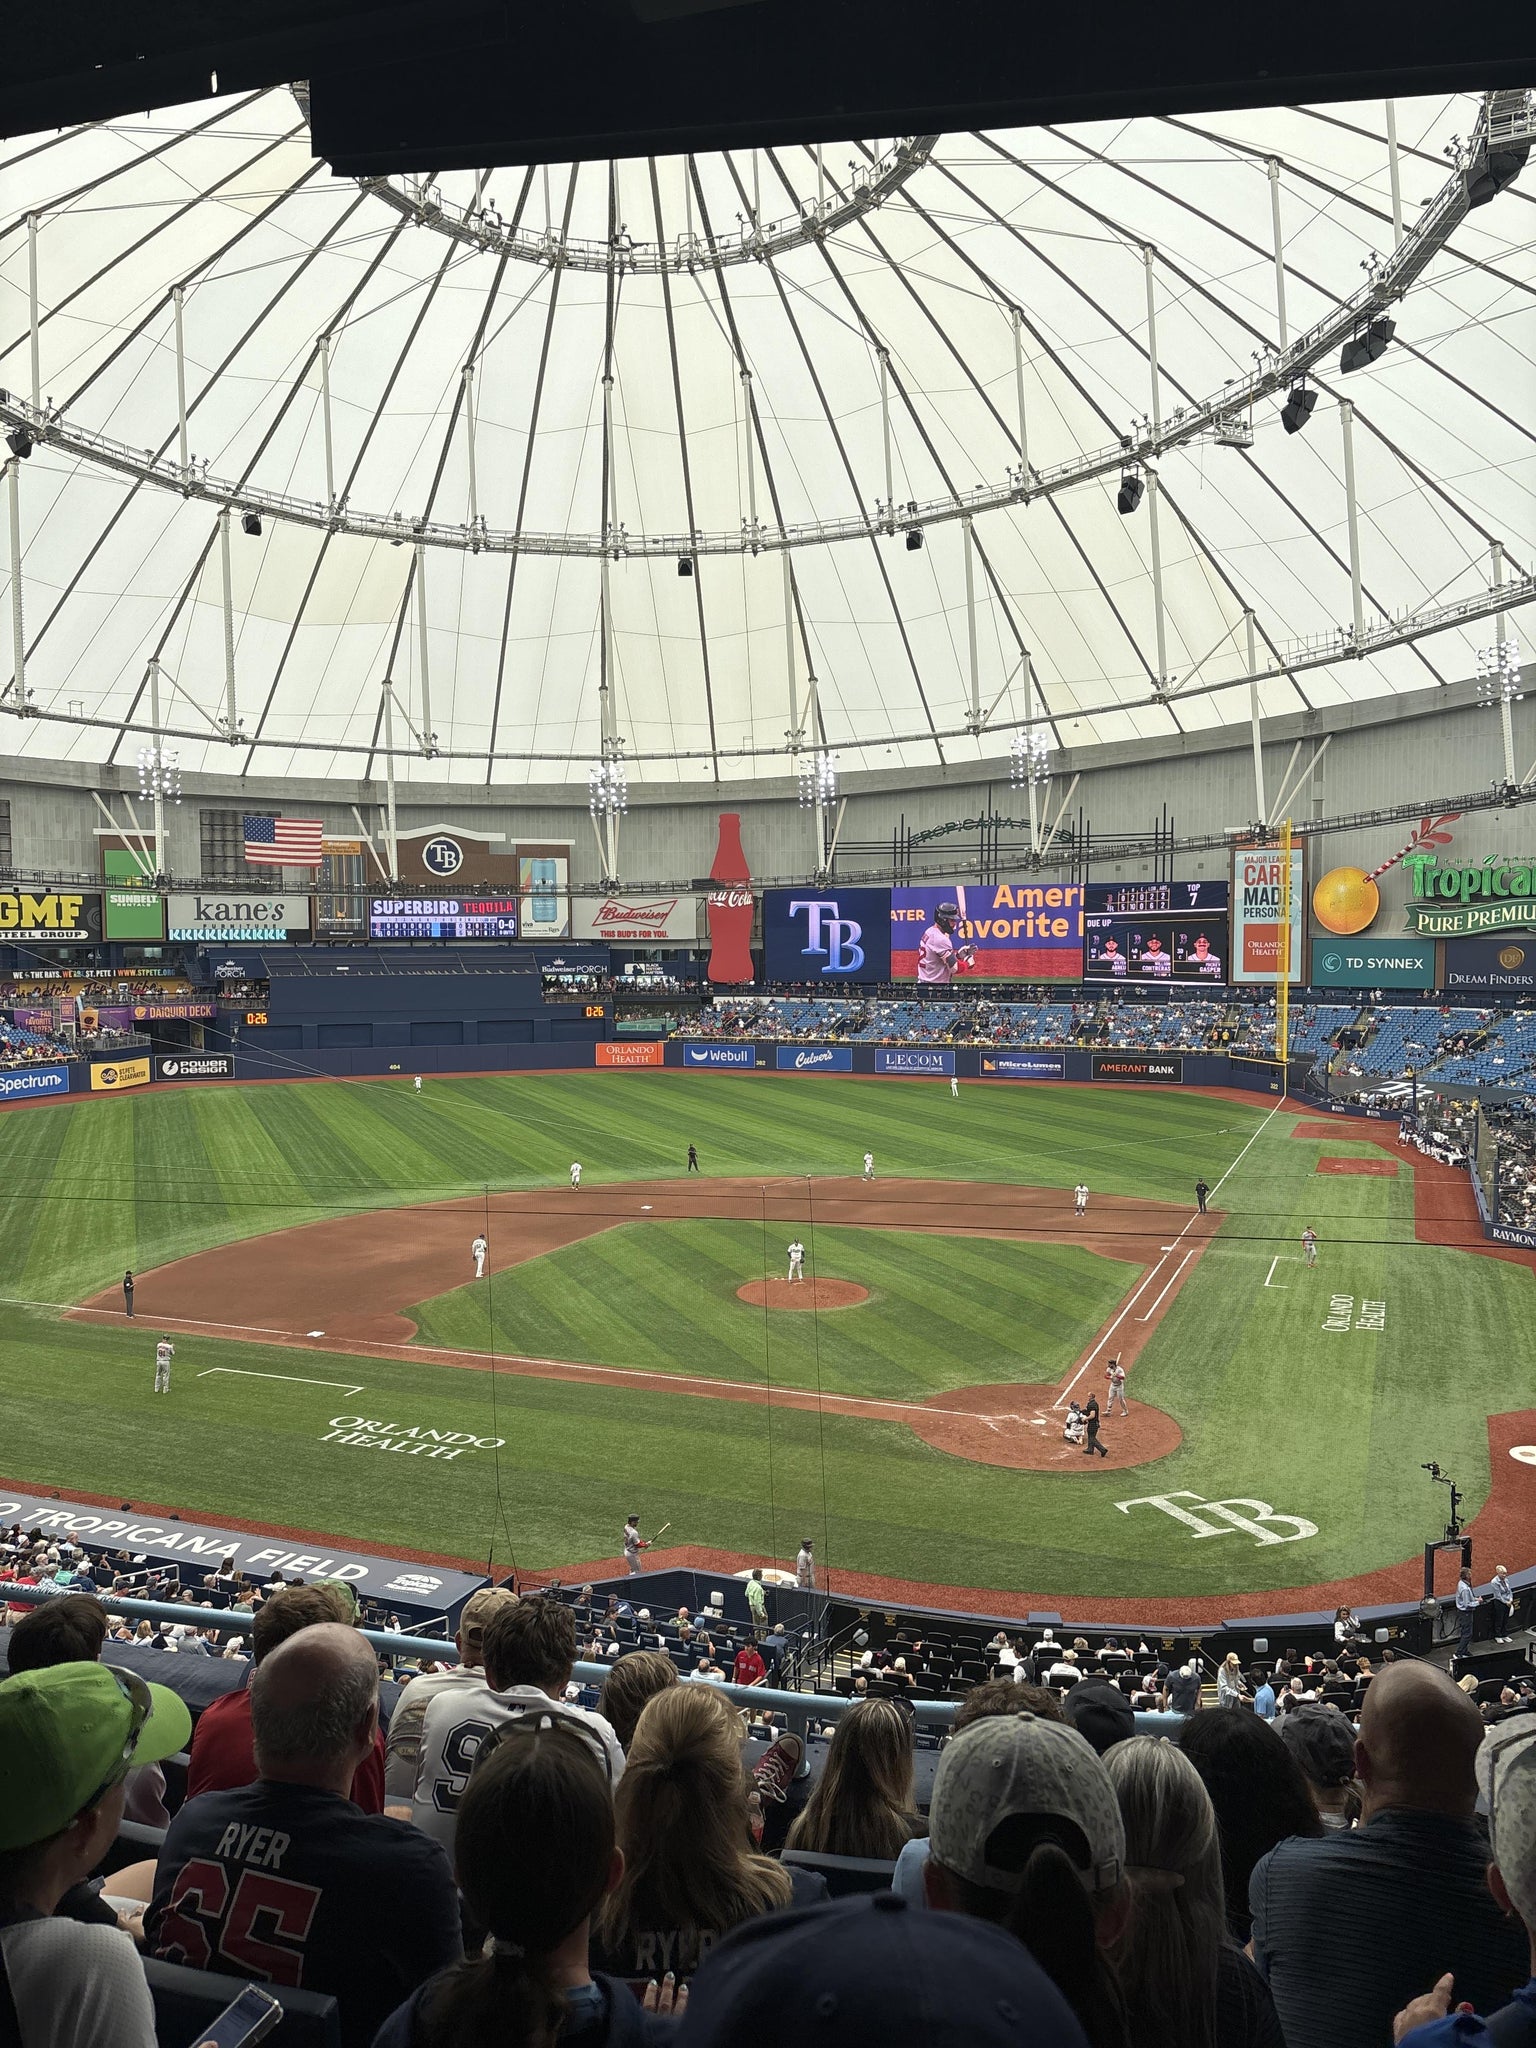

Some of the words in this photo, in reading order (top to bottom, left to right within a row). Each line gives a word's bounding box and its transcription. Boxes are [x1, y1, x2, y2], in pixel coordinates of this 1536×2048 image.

[430, 844, 457, 869] TB
[1244, 856, 1267, 864] MAJOR
[1244, 864, 1292, 886] CARE
[1187, 884, 1200, 892] TOP
[992, 884, 1084, 908] Ameri
[1190, 893, 1198, 906] 7
[1244, 887, 1292, 906] MADE
[0, 895, 82, 928] GMF
[194, 897, 285, 921] kane's
[373, 900, 459, 914] SUPERBIRD
[463, 901, 513, 914] TEQUILA
[600, 907, 669, 920] Budweiser
[1244, 907, 1291, 918] PERSONA
[891, 909, 925, 921] ATER
[499, 919, 514, 929] 0-0
[958, 911, 1069, 938] avorite
[1102, 919, 1112, 927] UP
[1418, 913, 1463, 931] PURE
[789, 901, 865, 973] TB
[1252, 948, 1283, 956] HEALTH
[1346, 958, 1363, 968] TD
[1368, 958, 1423, 969] SYNNEX
[30, 971, 44, 979] THE
[62, 970, 72, 978] WE
[117, 969, 176, 977] WWW.STPETE.ORG
[215, 970, 245, 978] PORCH
[1449, 973, 1487, 984] DREAM
[1490, 974, 1533, 985] FINDERS
[150, 1005, 187, 1018] DAIQUIRI
[190, 1005, 212, 1016] DECK
[586, 1006, 604, 1017] 0:26
[248, 1013, 267, 1024] 0:26
[606, 1046, 654, 1054] ORLANDO
[710, 1050, 747, 1062] Webull
[612, 1055, 649, 1063] HEALTH
[795, 1050, 833, 1068] Culver's
[999, 1060, 1061, 1069] MicroLumen
[120, 1070, 146, 1081] CLEARWATER
[1100, 1064, 1147, 1072] AMERANT
[1149, 1066, 1174, 1074] BANK
[0, 1075, 58, 1094] Spectrum
[1322, 1294, 1354, 1331] ORLANDO
[1356, 1300, 1386, 1331] HEALTH
[328, 1416, 506, 1449] ORLANDO
[317, 1429, 467, 1460] HEALTH
[1112, 1490, 1319, 1547] TB
[21, 1507, 242, 1558] TROPICANA
[245, 1548, 369, 1580] FIELD
[432, 1718, 499, 1813] 9
[215, 1821, 291, 1869] RYER
